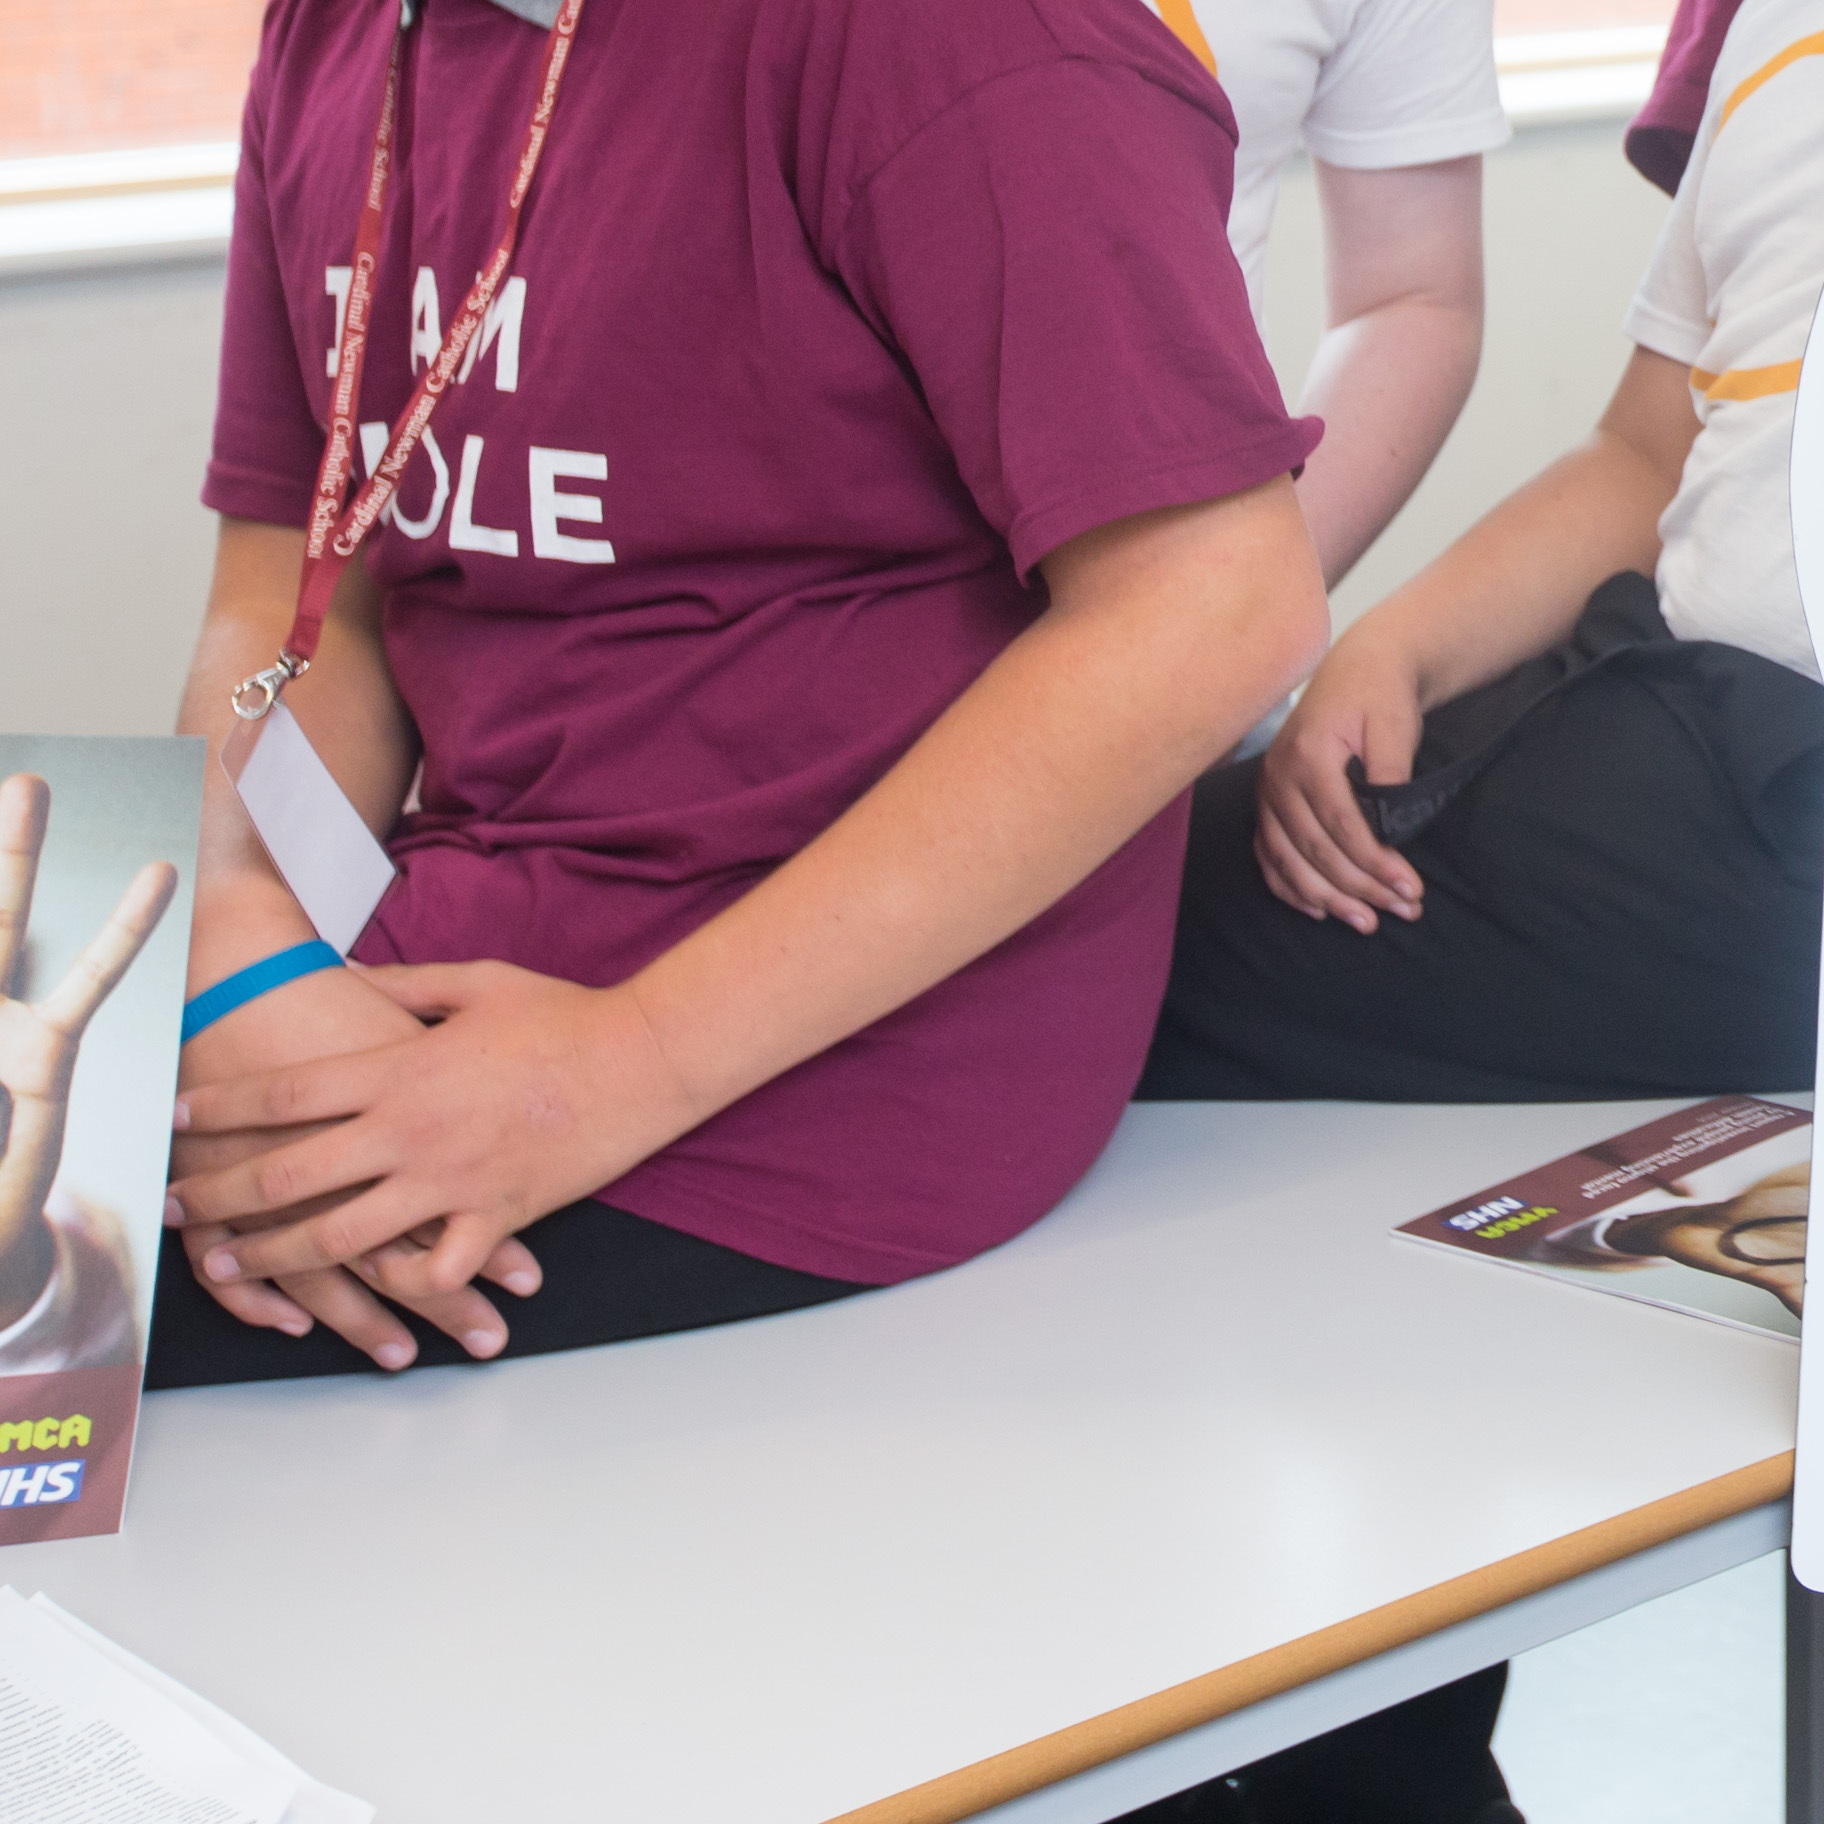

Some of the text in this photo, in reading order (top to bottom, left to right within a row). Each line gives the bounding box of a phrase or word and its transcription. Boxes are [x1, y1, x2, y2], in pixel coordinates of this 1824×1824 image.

[307, 251, 376, 560] Cardinal Newman Catholic School
[410, 265, 528, 393] AM
[333, 474, 393, 557] Cardinal
[374, 395, 435, 482] Newman
[425, 308, 480, 393] Catholic
[1449, 1196, 1524, 1231] NHS
